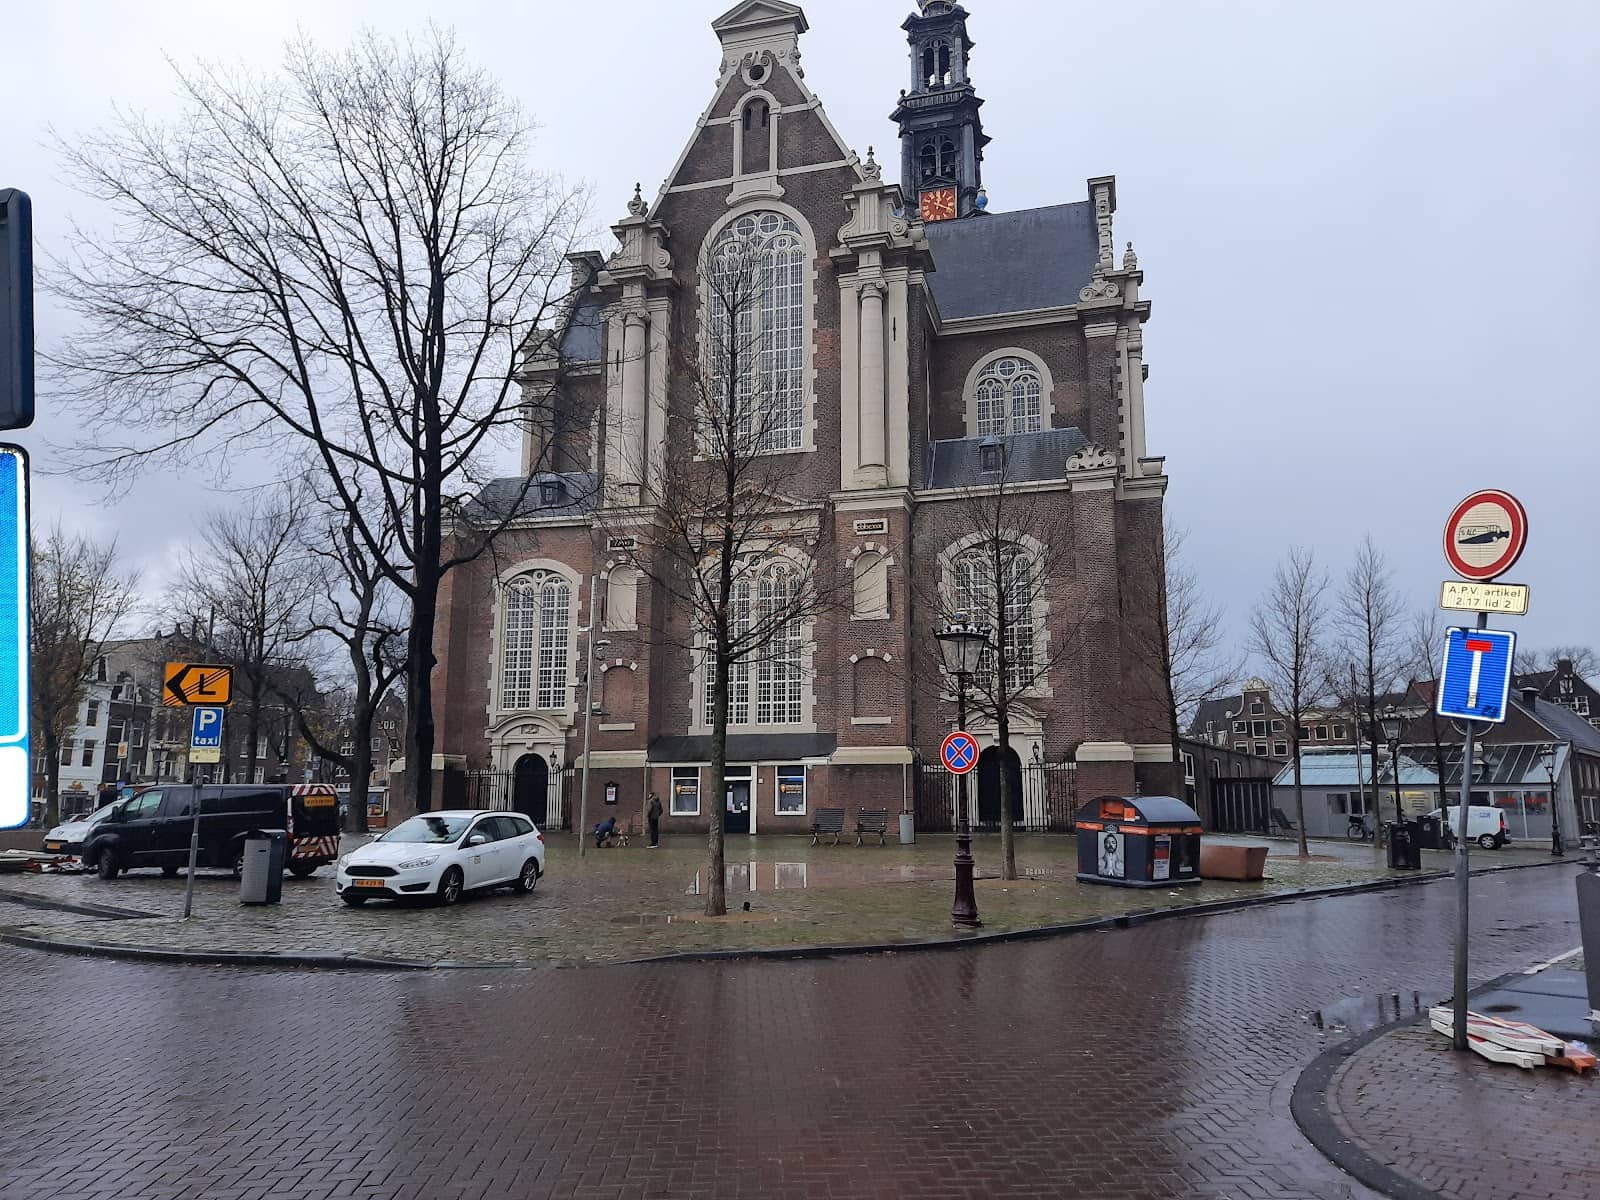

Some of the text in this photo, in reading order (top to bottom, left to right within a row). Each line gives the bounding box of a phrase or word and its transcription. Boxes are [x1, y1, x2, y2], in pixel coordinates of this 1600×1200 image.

[1484, 587, 1521, 597] artikel
[1456, 597, 1511, 608] 2.17 lid 2
[199, 673, 216, 695] L
[199, 710, 217, 731] P
[195, 735, 218, 745] taxi
